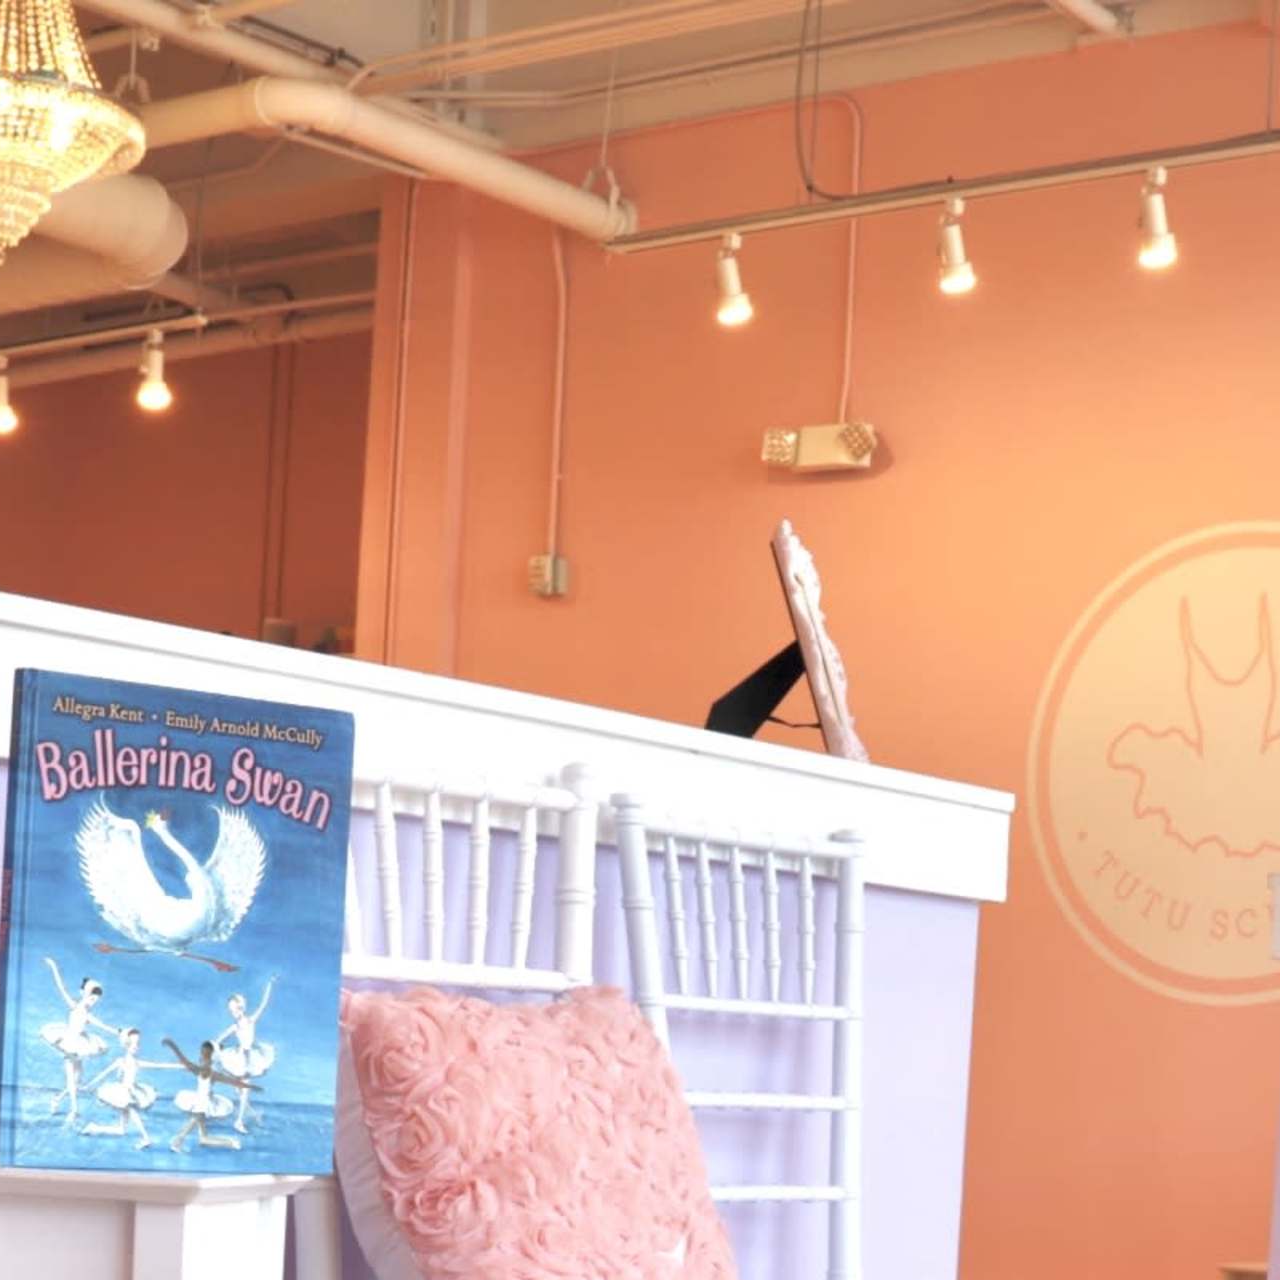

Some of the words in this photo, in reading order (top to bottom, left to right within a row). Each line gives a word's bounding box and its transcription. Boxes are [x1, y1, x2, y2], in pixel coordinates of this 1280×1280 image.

[53, 696, 105, 721] Allegra
[109, 704, 144, 723] Kent
[165, 711, 207, 732] Emily
[210, 718, 259, 738] Arnold
[262, 724, 324, 750] McCully
[36, 728, 216, 801] Ballerina
[225, 746, 333, 831] Swan
[1092, 850, 1192, 931] TUTU
